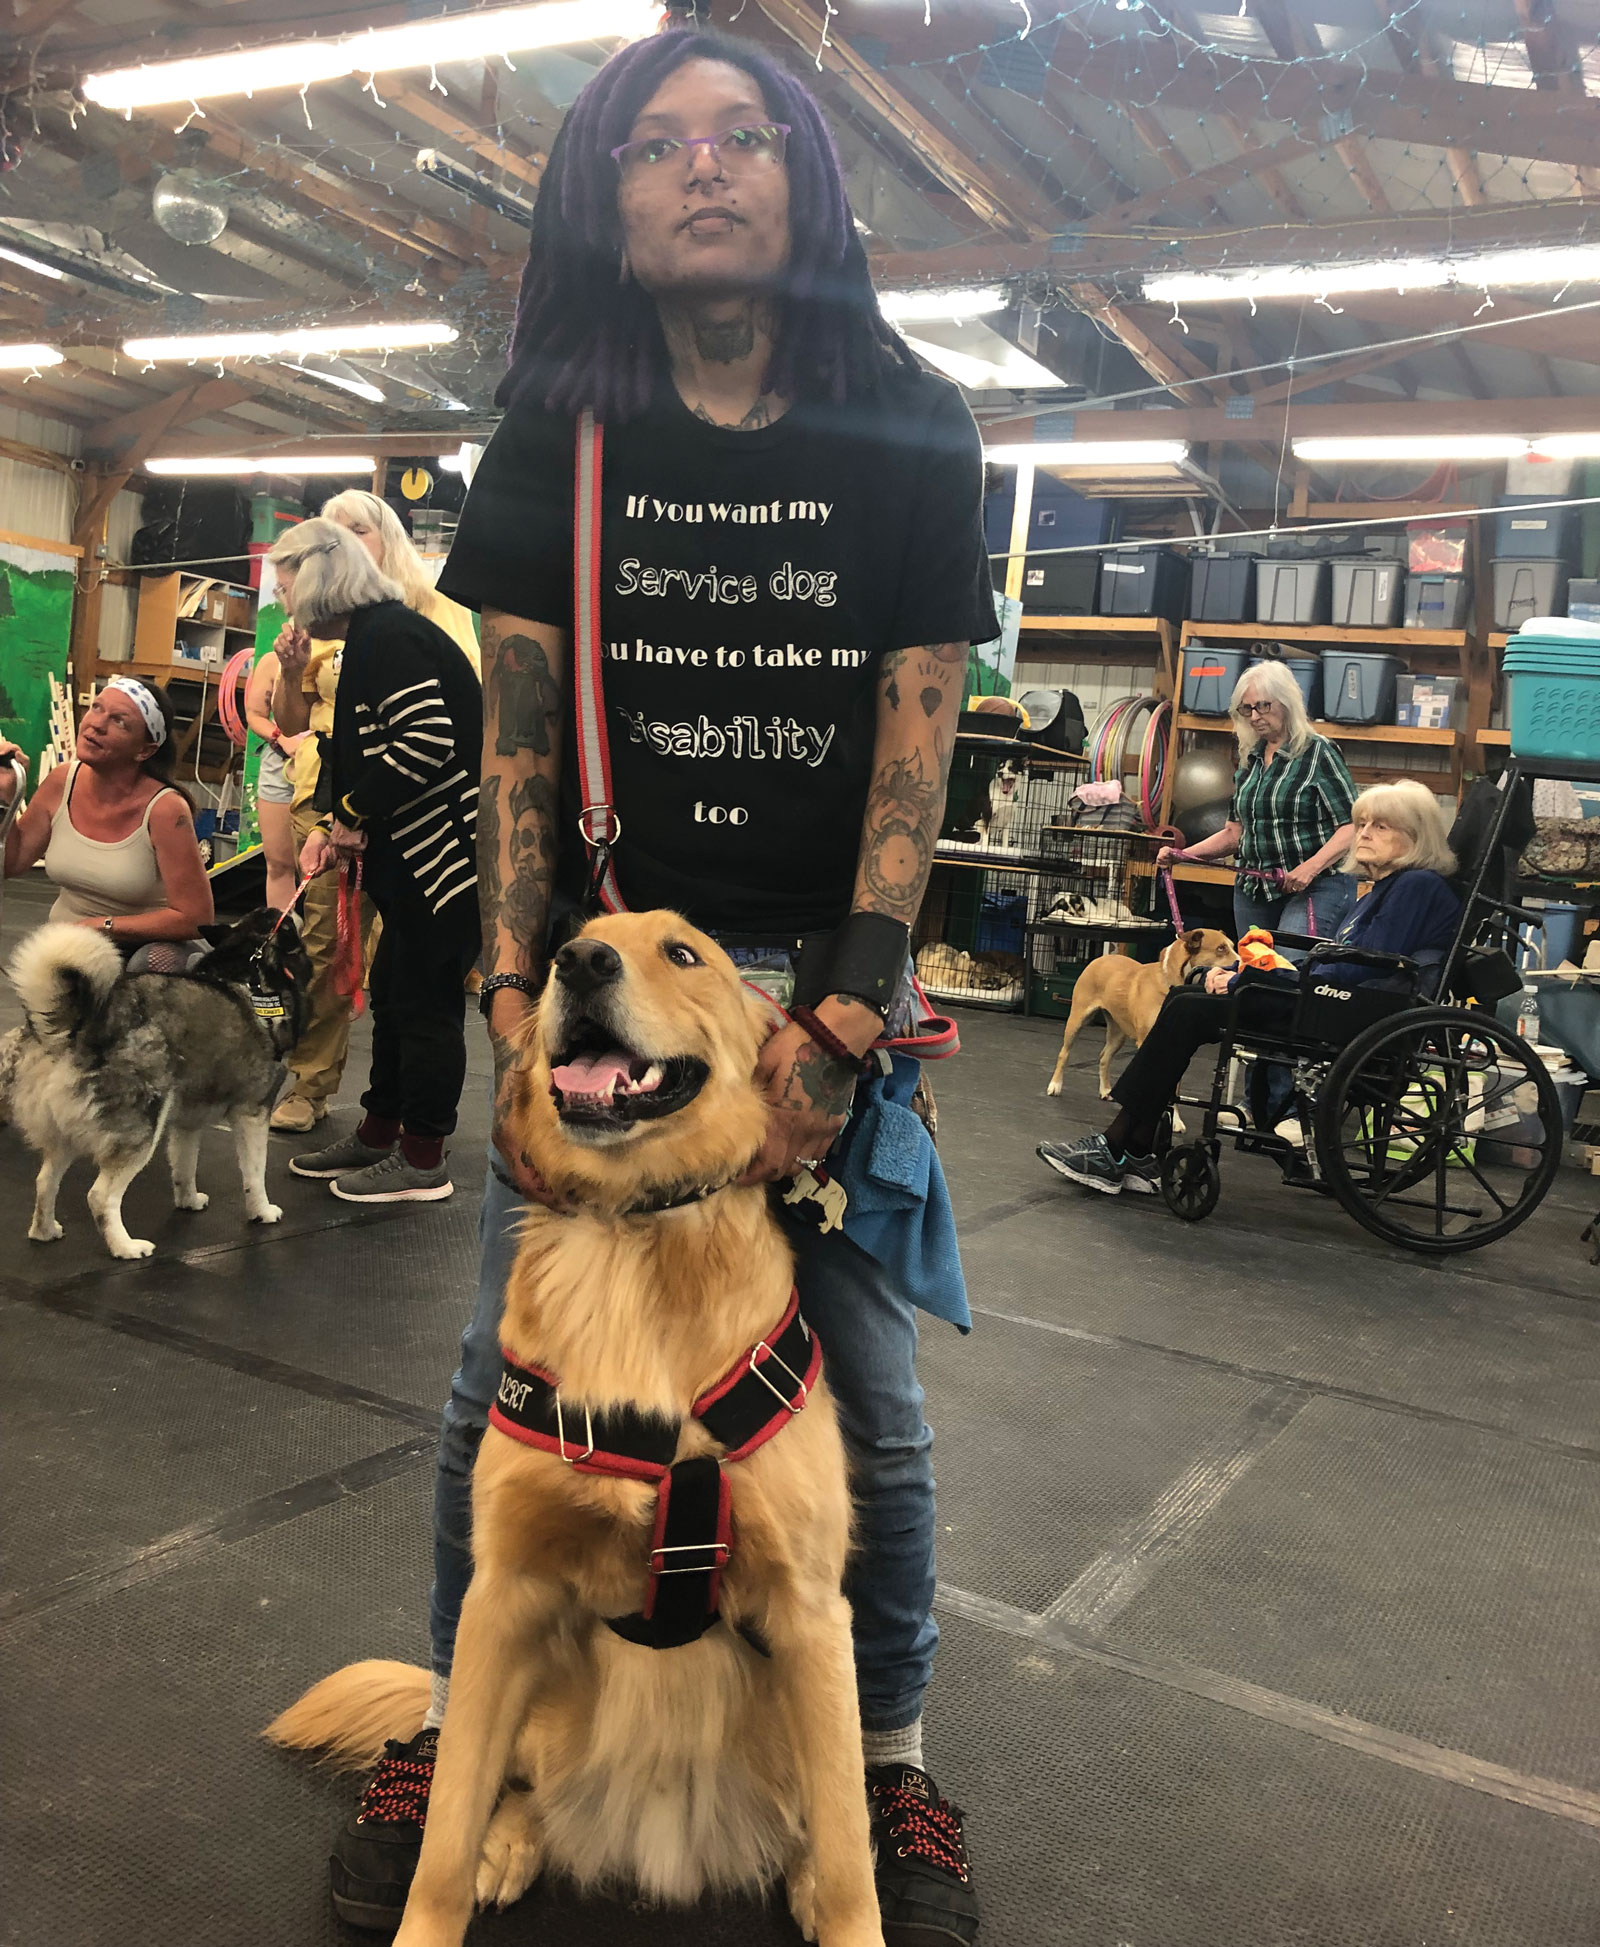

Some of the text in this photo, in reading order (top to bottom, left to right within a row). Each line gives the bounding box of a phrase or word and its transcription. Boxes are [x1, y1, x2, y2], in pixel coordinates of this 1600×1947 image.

[626, 495, 833, 526] If you want my
[615, 558, 837, 607] Service dog
[636, 639, 708, 666] have
[715, 646, 745, 667] to
[752, 644, 822, 666] take
[616, 707, 835, 767] isability
[694, 801, 748, 825] too
[1314, 984, 1351, 1000] drive
